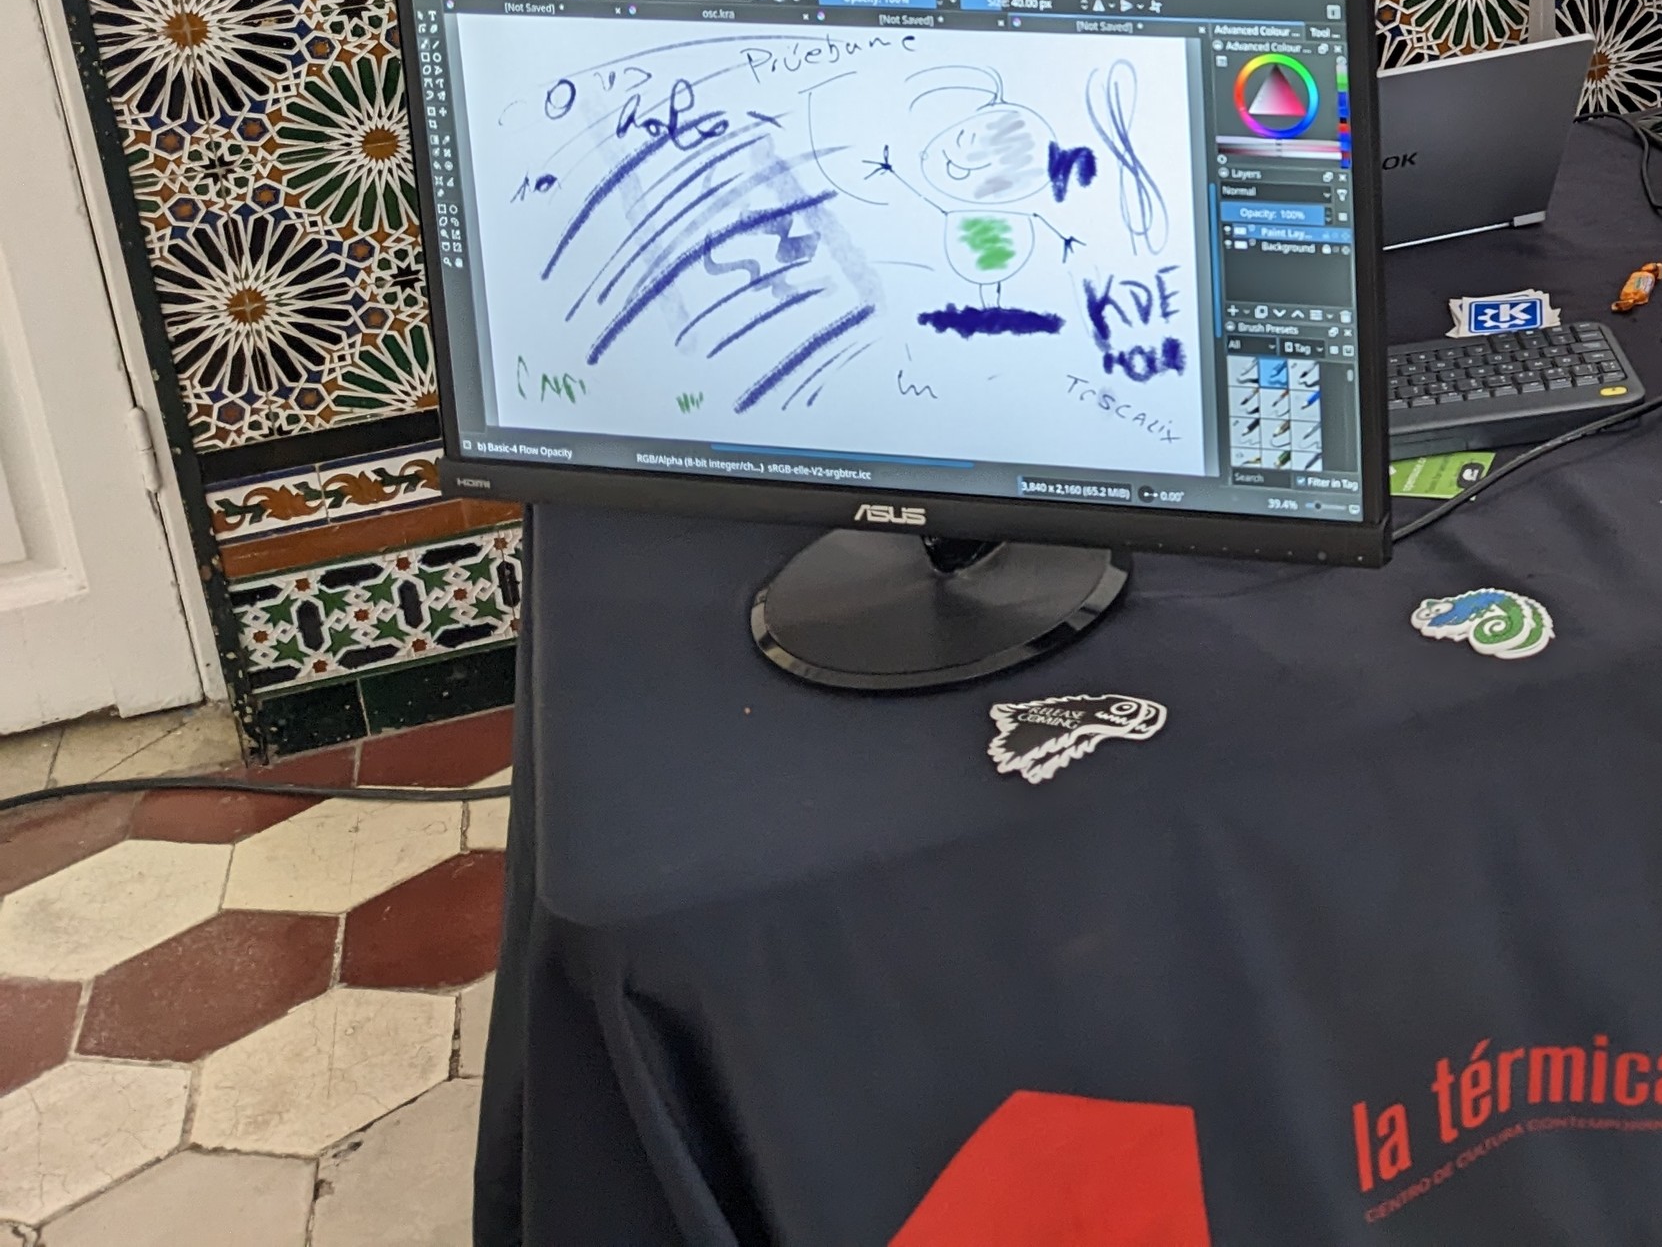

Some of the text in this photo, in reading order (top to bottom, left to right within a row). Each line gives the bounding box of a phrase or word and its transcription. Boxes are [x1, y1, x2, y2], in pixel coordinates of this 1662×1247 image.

[504, 2, 555, 15] [Not Saved]
[1039, 0, 1052, 10] px
[702, 9, 735, 20] osc.kra
[879, 14, 934, 27] [Not Saved]
[1076, 20, 1133, 33] [Not Saved]
[1214, 25, 1291, 37] Advanced Colour
[1310, 28, 1331, 38] Tool
[1226, 41, 1302, 52] Advanced Colour
[1232, 169, 1261, 180] Layers
[1222, 186, 1256, 196] Normal
[1240, 208, 1305, 220] Opacity: 100%
[1261, 227, 1286, 237] Paint
[1262, 242, 1315, 253] Background
[1083, 264, 1181, 345] KDE
[1238, 323, 1299, 335] Brush Presets
[1228, 339, 1240, 349] All
[1294, 343, 1310, 354] Tag
[477, 442, 573, 459] b) Basic-4 Flow Opacity
[636, 453, 683, 467] RGB/Alpha
[684, 457, 707, 468] (8-bit
[457, 477, 491, 489] HDMI
[1234, 473, 1264, 483] Search
[1307, 477, 1358, 491] Filter in Tag
[1021, 481, 1046, 493] 3,840
[1055, 483, 1081, 495] 2,160
[1083, 486, 1106, 497] (65.2
[1107, 487, 1130, 500] MiB)
[1268, 498, 1297, 510] 39.4%
[854, 504, 927, 526] ASUS
[1029, 706, 1088, 721] RELEASE
[1018, 713, 1081, 729] COMING
[1352, 1100, 1413, 1194] la
[1364, 1176, 1431, 1223] CENTRO
[1433, 1160, 1455, 1186] DE
[1456, 1124, 1524, 1169] CULTURA
